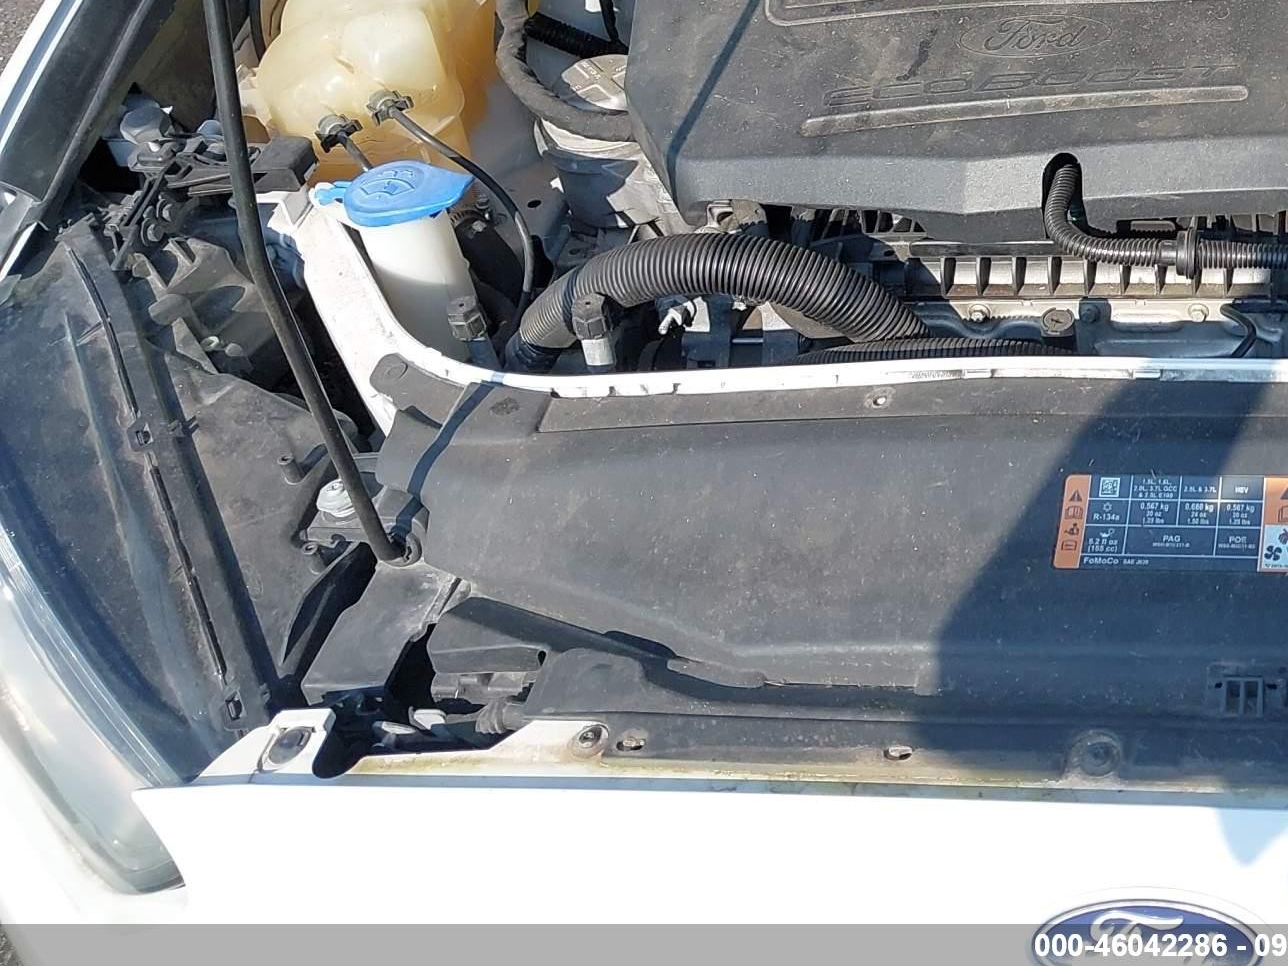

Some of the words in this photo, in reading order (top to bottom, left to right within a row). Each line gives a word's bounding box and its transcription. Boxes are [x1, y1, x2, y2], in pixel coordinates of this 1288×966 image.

[984, 18, 1088, 51] Ford
[1160, 502, 1170, 512] kg
[1205, 504, 1214, 512] kg
[1246, 504, 1255, 513] kg
[1093, 513, 1120, 521] R-134a
[1083, 557, 1119, 565] FoMoCo
